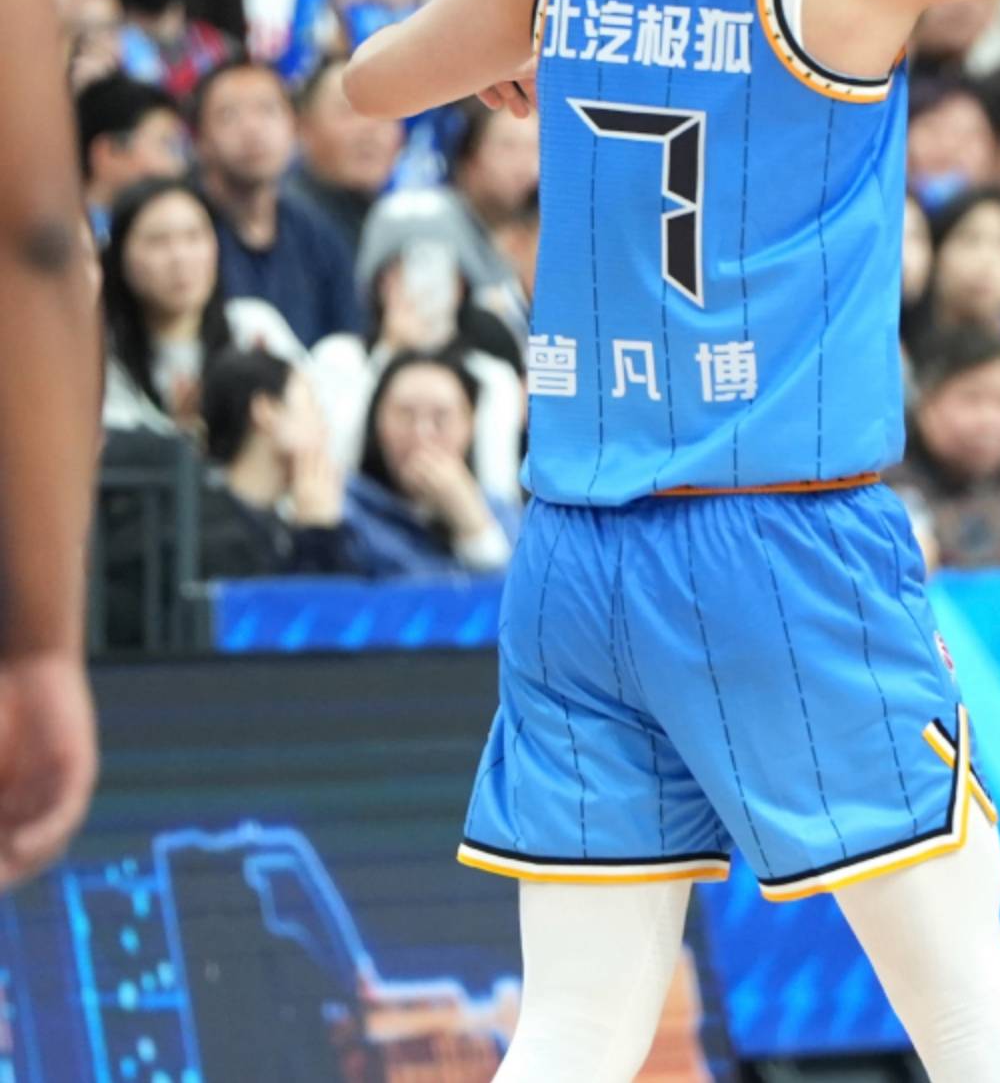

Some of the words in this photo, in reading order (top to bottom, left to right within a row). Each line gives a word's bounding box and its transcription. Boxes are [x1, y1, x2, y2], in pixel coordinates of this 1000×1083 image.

[565, 97, 707, 309] 7
[526, 334, 758, 403] 曾凡博
